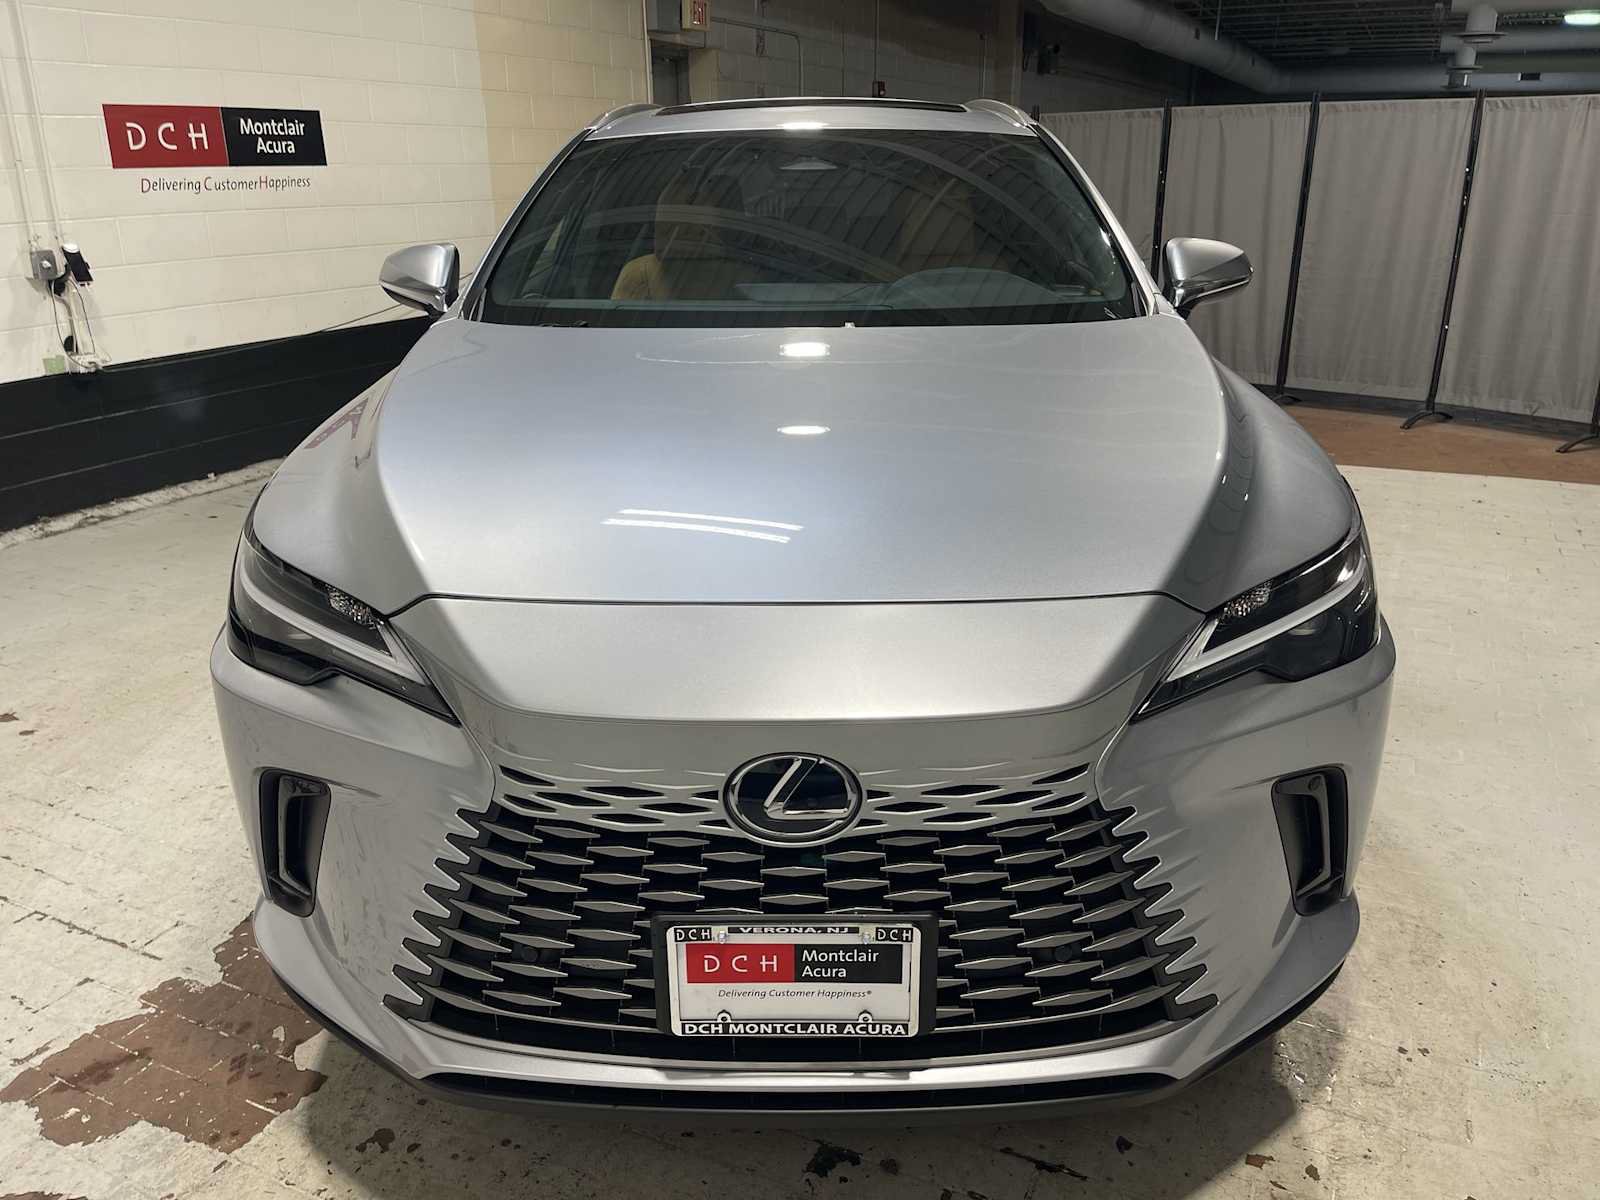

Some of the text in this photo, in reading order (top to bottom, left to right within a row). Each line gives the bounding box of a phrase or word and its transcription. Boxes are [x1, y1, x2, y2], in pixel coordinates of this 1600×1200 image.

[239, 117, 306, 136] Montclair
[126, 122, 209, 150] DCH
[256, 137, 296, 154] Acura
[140, 176, 311, 194] Delivering Customer Happiness
[675, 928, 711, 941] DCH
[827, 926, 849, 934] NJ
[877, 928, 912, 941] DCH
[802, 949, 879, 963] Montclair
[704, 954, 778, 973] DCH
[802, 966, 847, 978] Acura
[718, 989, 767, 999] Delivering
[768, 989, 816, 998] Customer
[685, 1023, 906, 1035] DCH MONTCLAIR ACURA
